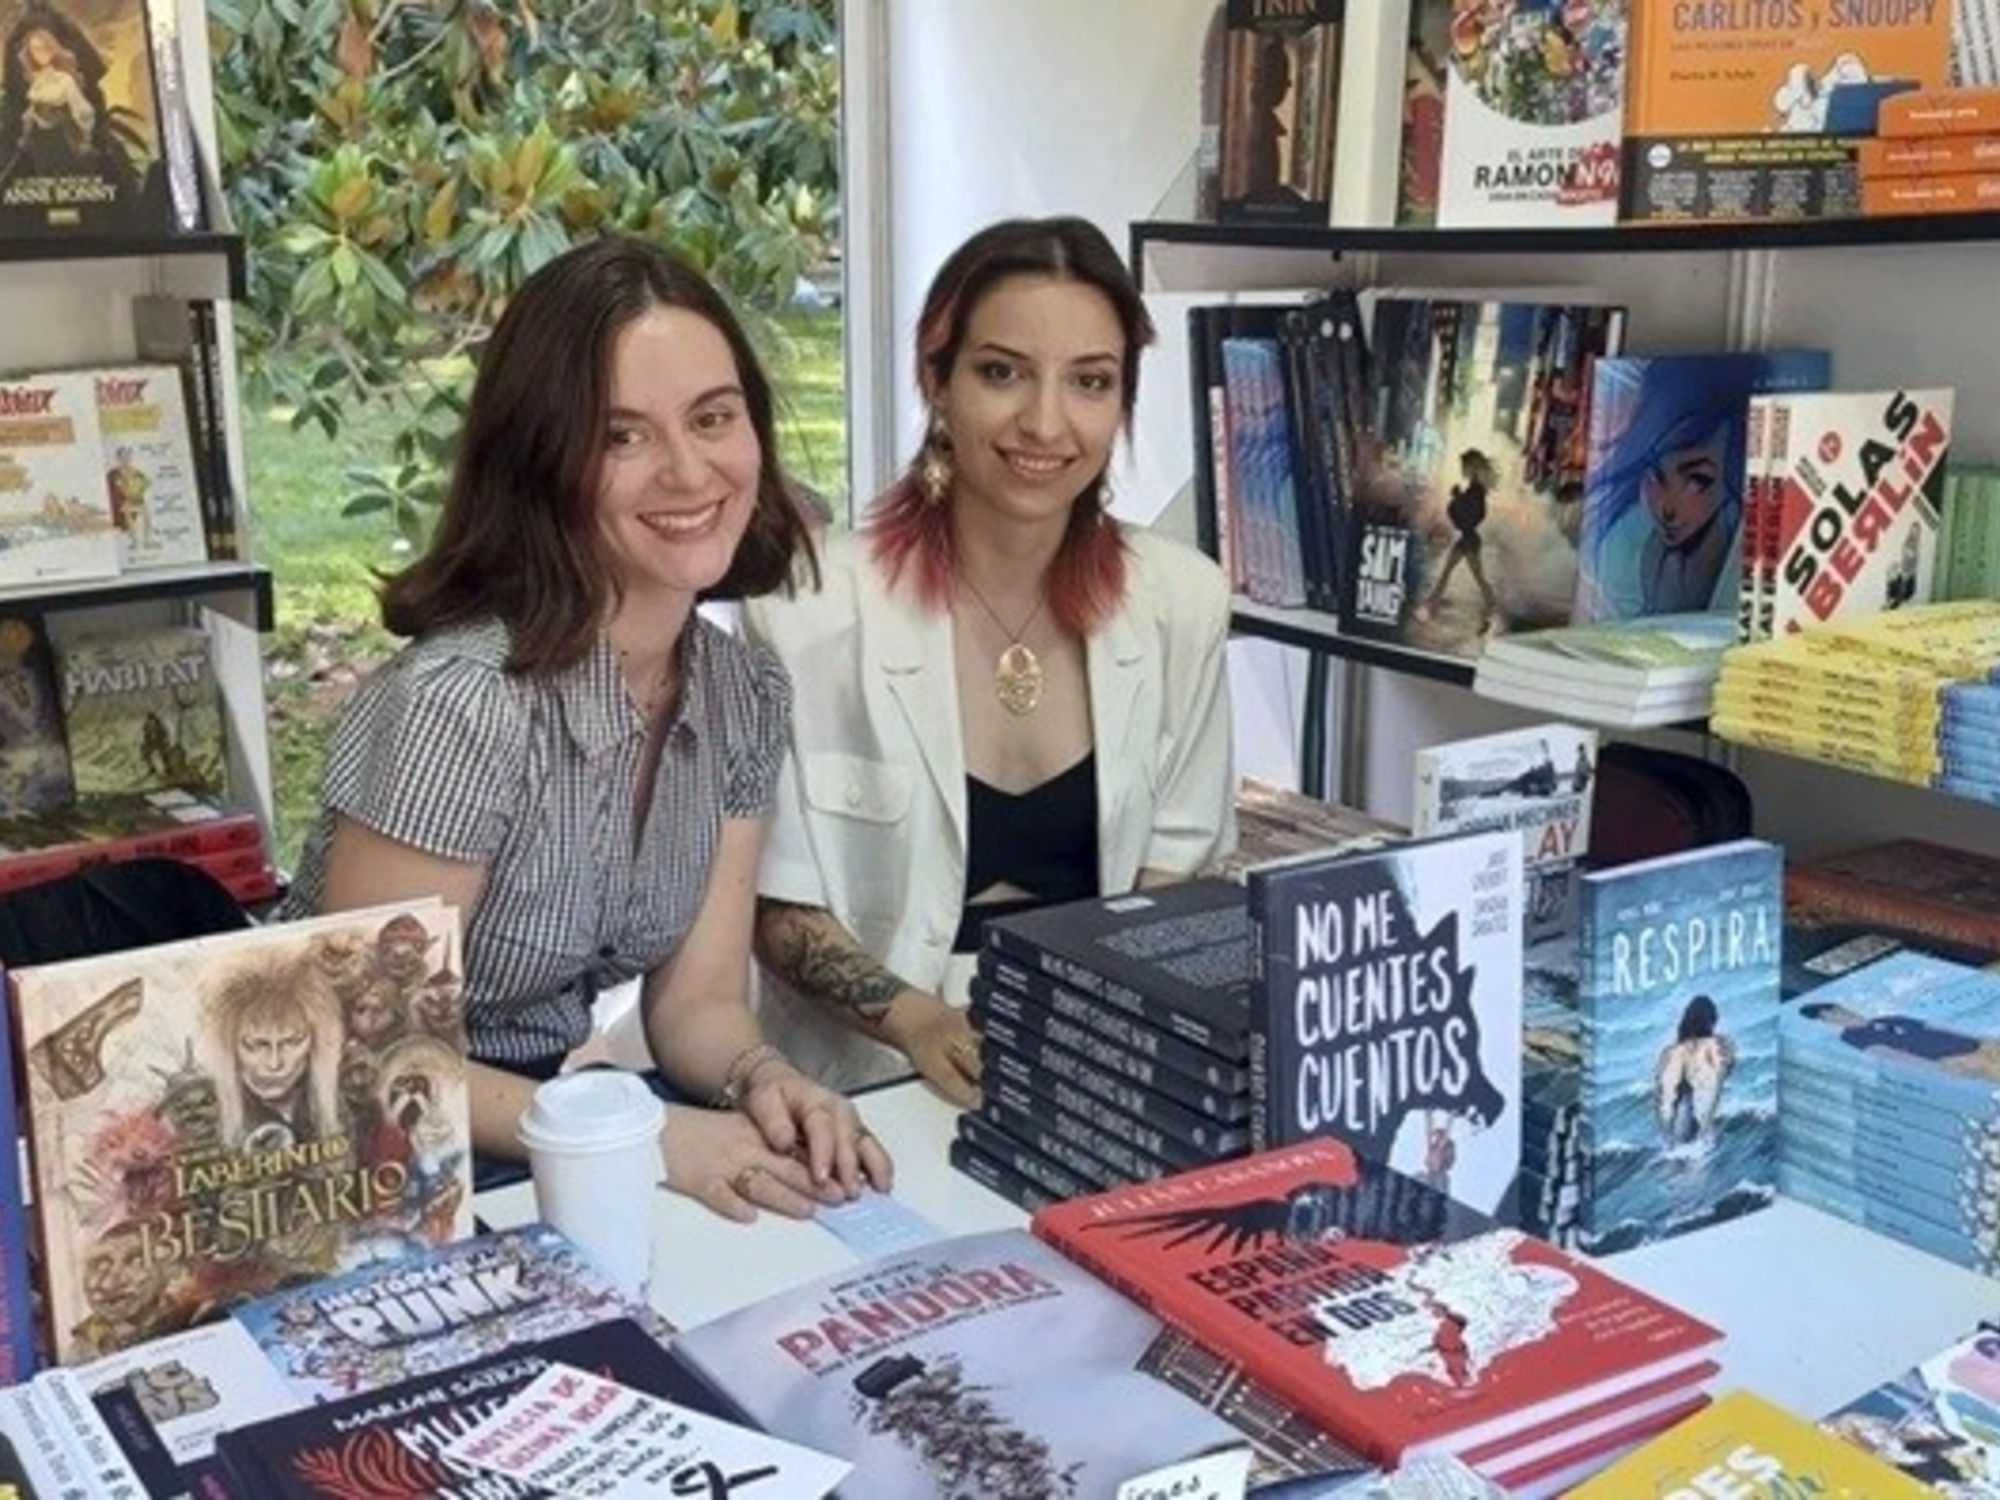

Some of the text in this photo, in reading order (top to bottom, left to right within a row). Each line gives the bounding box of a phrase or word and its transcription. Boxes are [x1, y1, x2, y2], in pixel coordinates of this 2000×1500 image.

[1673, 0, 1803, 31] CARLITOS
[1828, 0, 1936, 28] SNOOPY
[1784, 390, 1919, 597] SOLAS
[64, 655, 205, 695] HABITAT
[1297, 901, 1343, 970] NO
[1353, 890, 1398, 956] ME
[1612, 904, 1770, 994] RESPIRA
[1296, 946, 1451, 1048] CUENTES
[1298, 1016, 1468, 1135] CUENTOS
[140, 1161, 407, 1269] BESTIARIO
[329, 1264, 541, 1346] PUNK
[777, 1261, 1056, 1369] PANDORA
[1268, 1291, 1418, 1347] EN DOS
